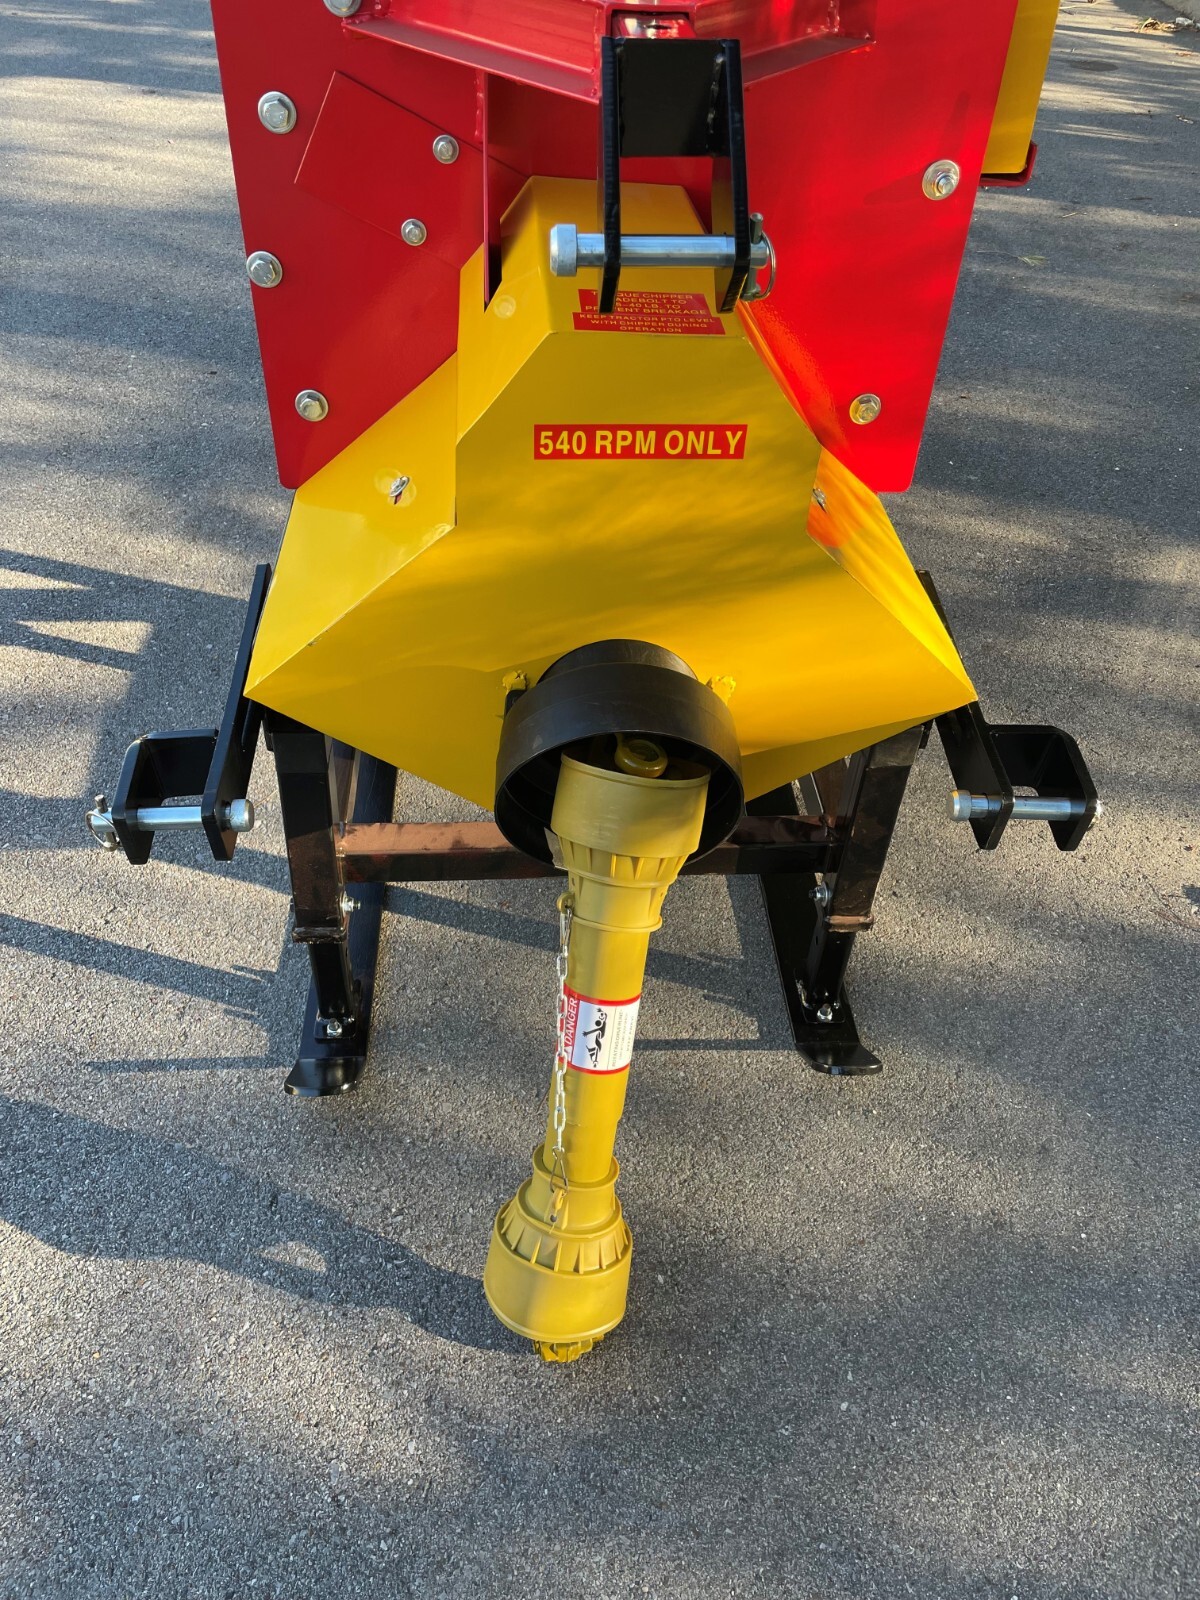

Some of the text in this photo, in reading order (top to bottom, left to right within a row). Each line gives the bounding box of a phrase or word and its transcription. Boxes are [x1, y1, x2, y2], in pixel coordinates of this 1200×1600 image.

[590, 290, 639, 298] TQUE
[585, 305, 640, 313] PRENT
[539, 430, 743, 455] 540 RPM ONLY
[564, 996, 578, 1046] DANGER
